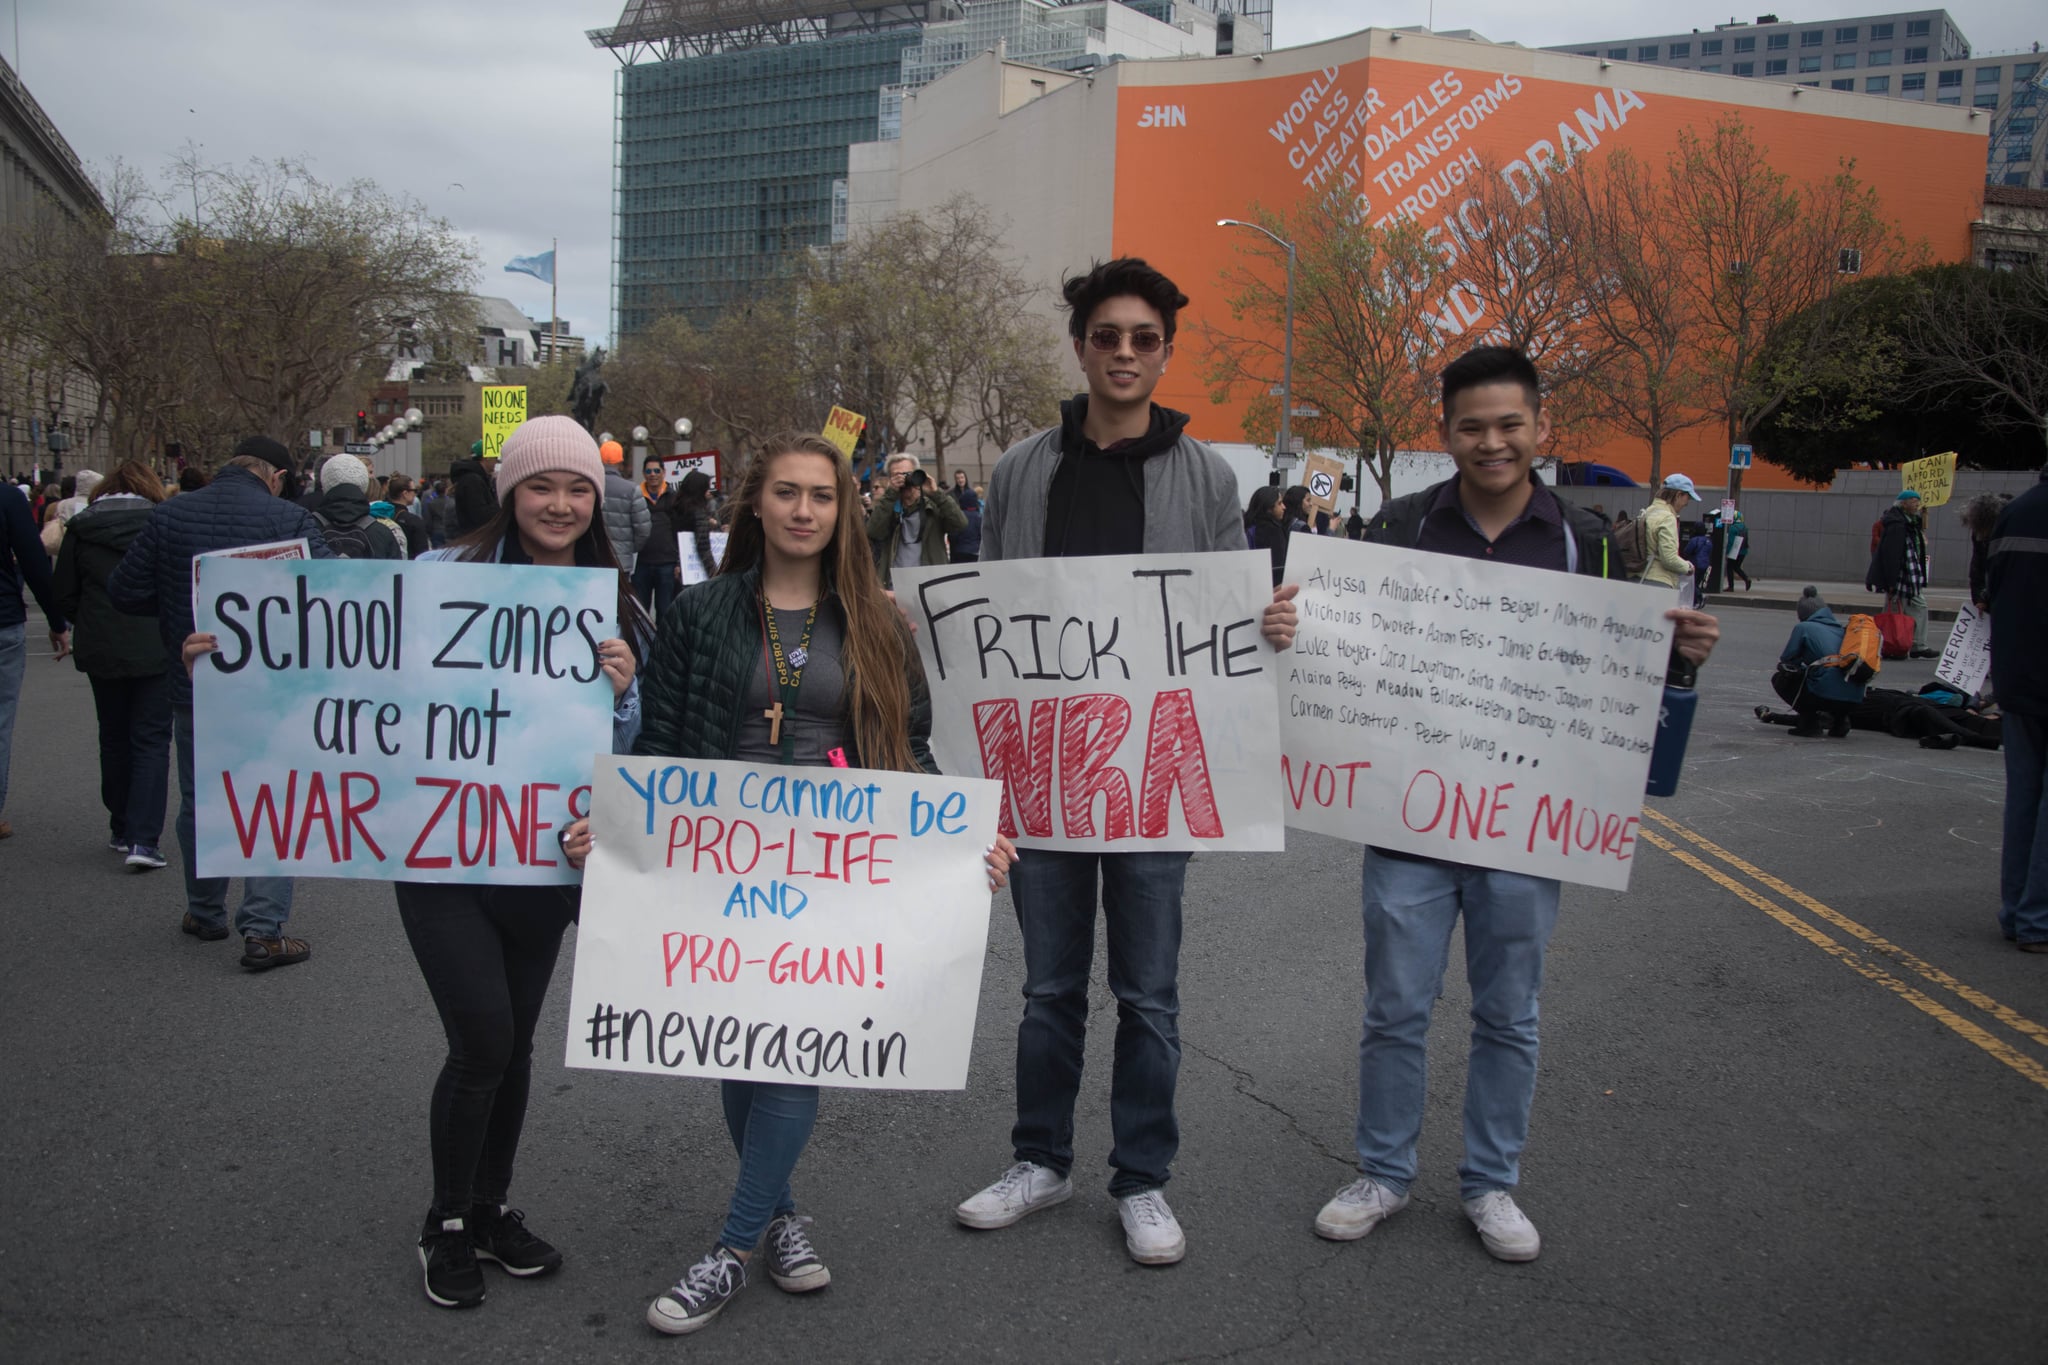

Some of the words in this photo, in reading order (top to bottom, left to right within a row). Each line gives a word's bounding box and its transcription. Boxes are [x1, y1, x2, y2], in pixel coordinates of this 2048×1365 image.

[1137, 104, 1187, 128] SHN
[1268, 64, 1339, 144] WORLD
[1288, 88, 1350, 170] CLASS
[1302, 87, 1386, 192] THEATER
[1362, 70, 1464, 162] DAZZLES
[1372, 72, 1524, 196] TRANSFORMS
[1501, 87, 1647, 208] DRAMA
[1372, 146, 1481, 237] THROUGH
[1401, 278, 1486, 373] AND
[484, 390, 503, 409] NO
[504, 390, 526, 409] ONE
[484, 411, 522, 425] NEEDS
[829, 408, 862, 438] NRA
[675, 457, 703, 470] ARMS
[1906, 468, 1945, 484] AFFORD
[918, 570, 1131, 682] FRICK
[1132, 568, 1263, 678] THE
[1303, 598, 1362, 626] Nicholas
[1308, 567, 1367, 598] Alyssa
[1453, 588, 1493, 612] Scott
[1499, 596, 1540, 623] Beigel
[772, 642, 789, 685] OBISPO
[1295, 630, 1330, 659] Luke
[1337, 637, 1372, 666] Hoyer
[1379, 643, 1407, 671] Cara
[1599, 695, 1640, 718] Oliver
[1938, 605, 1976, 679] AMERICA!
[1289, 668, 1332, 687] Alaina
[1375, 678, 1424, 699] Meadow
[1289, 693, 1334, 721] Carmen
[1414, 721, 1454, 744] Peter
[313, 696, 402, 756] are
[425, 687, 512, 766] not
[972, 687, 1225, 842] NRA
[221, 769, 387, 864] WAR
[739, 771, 882, 825] cannot
[910, 789, 970, 837] be
[1402, 769, 1516, 841] ONE
[1526, 793, 1641, 861] MORE
[665, 813, 898, 885] PRO-LIFE
[723, 879, 809, 920] AND
[662, 931, 886, 990] PRO-GUN!
[585, 1002, 908, 1079] #neveragain
